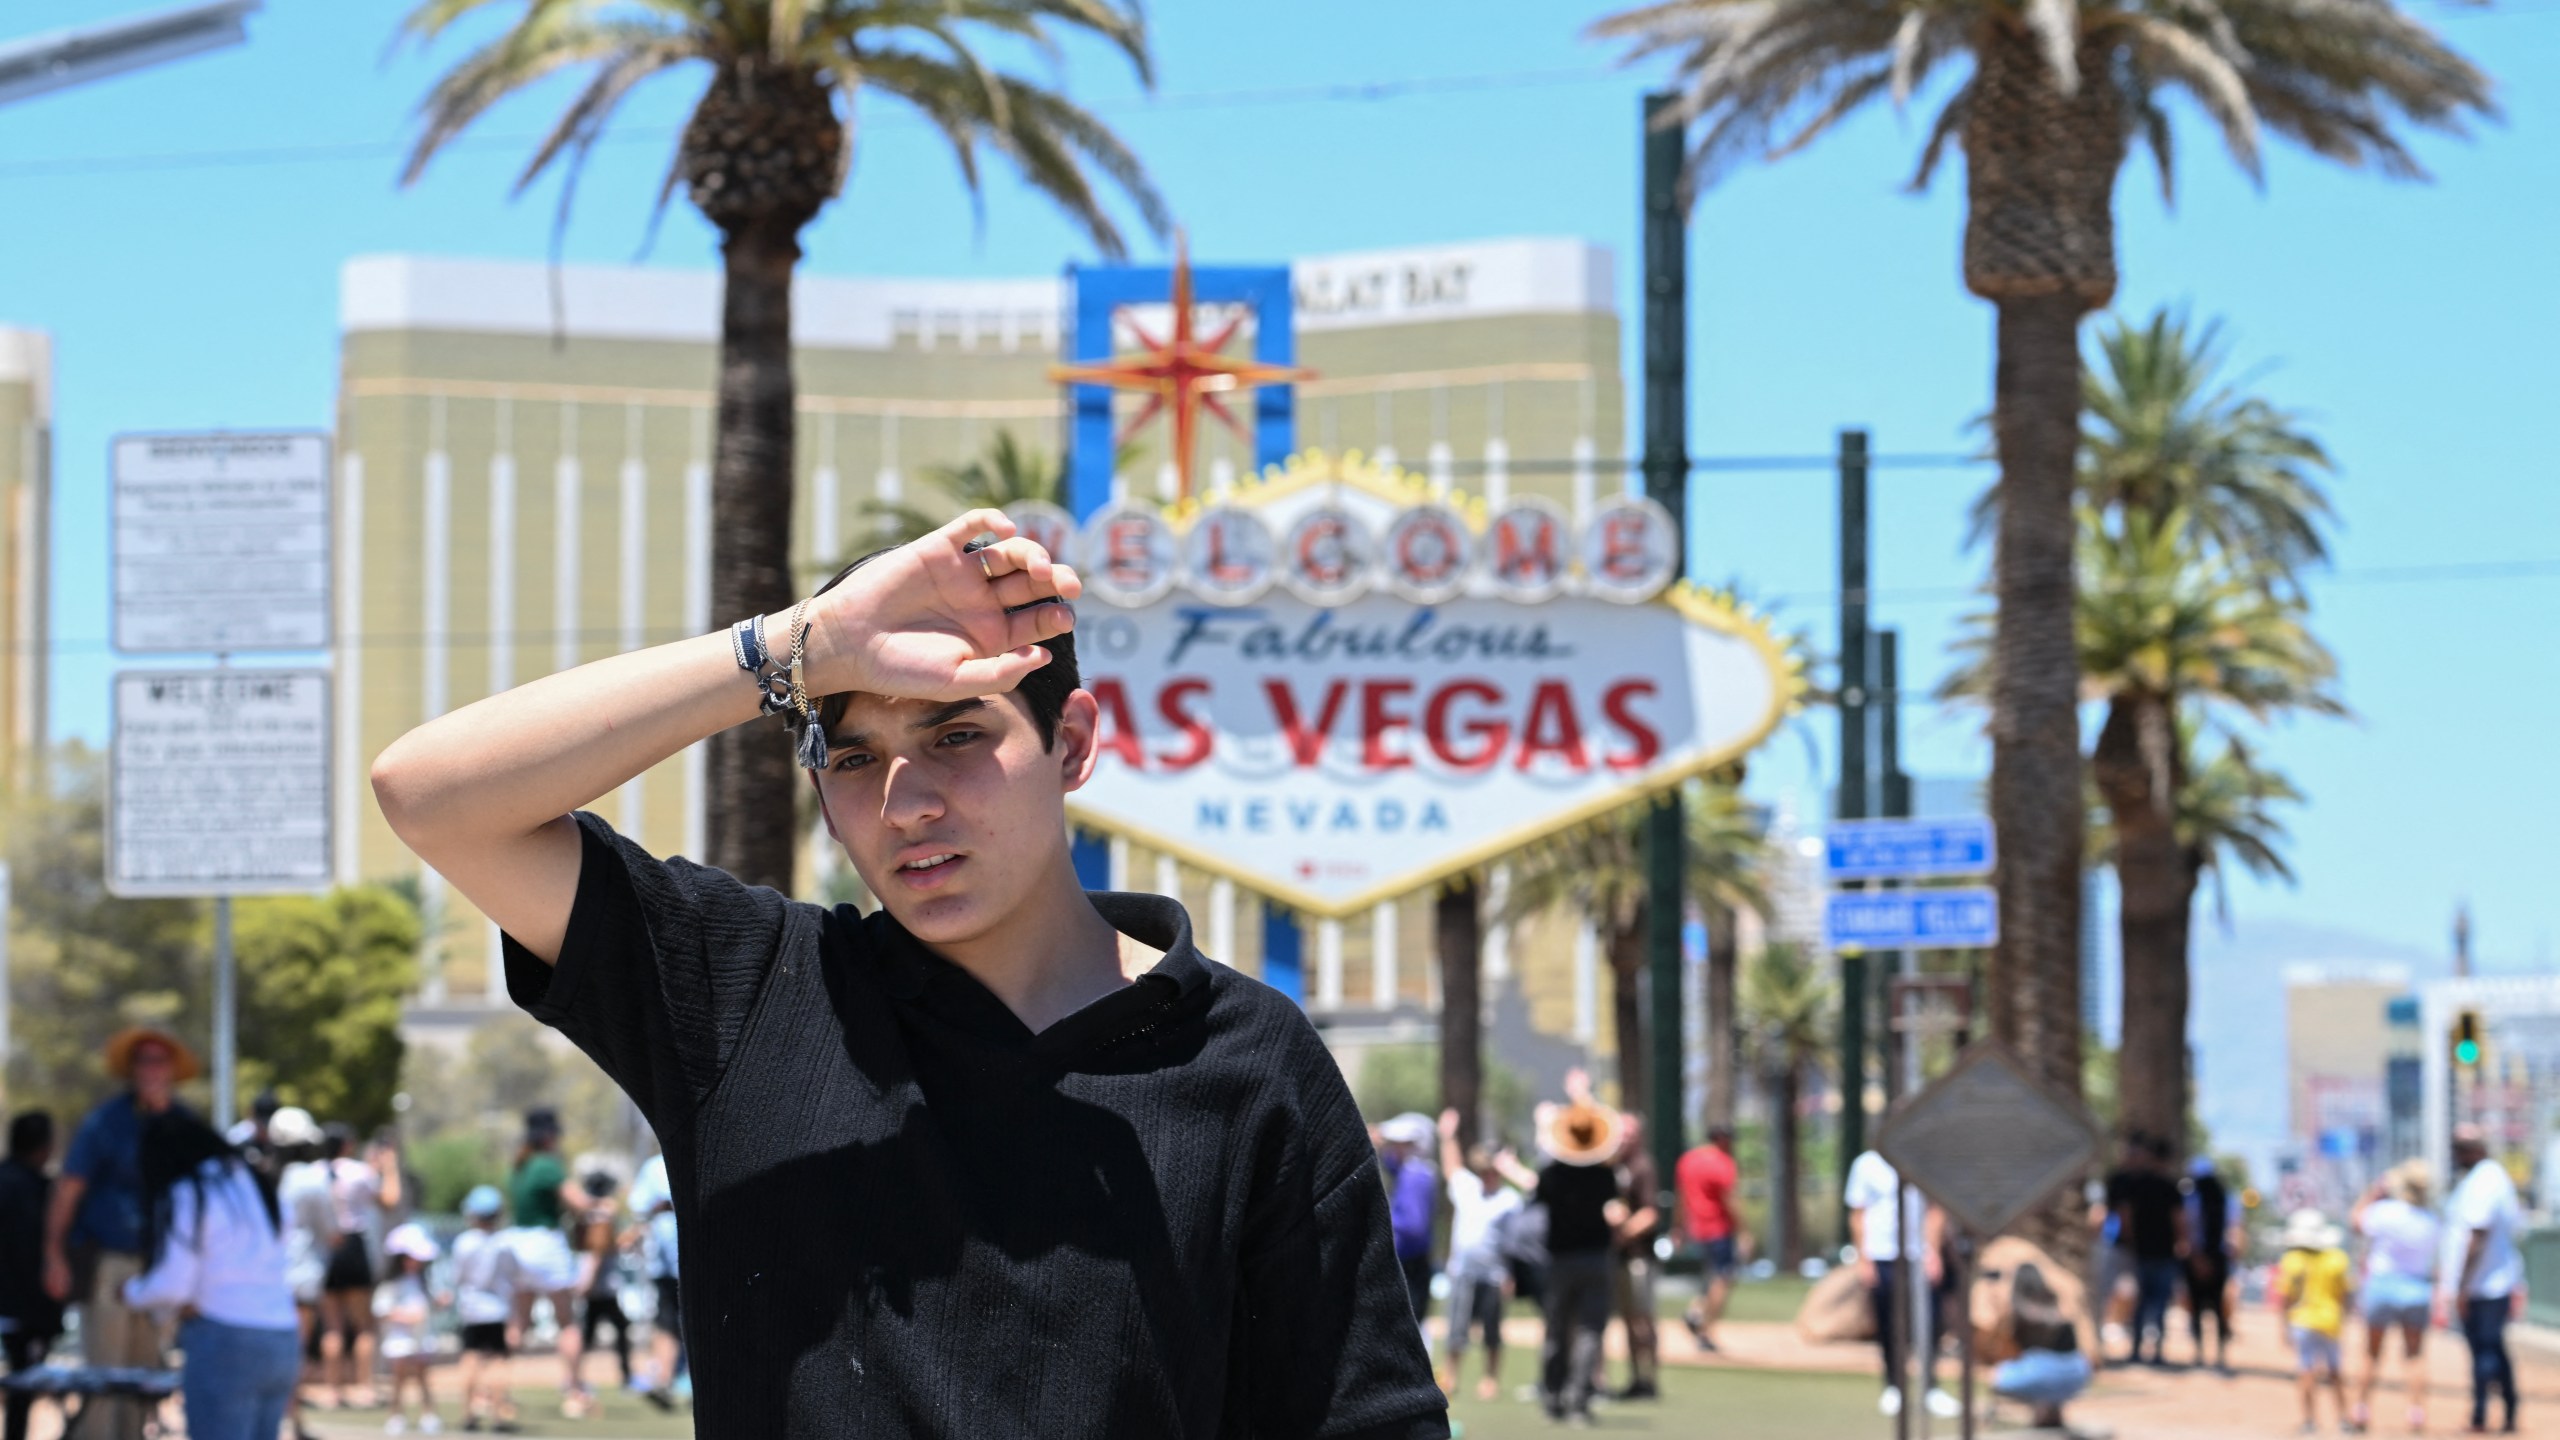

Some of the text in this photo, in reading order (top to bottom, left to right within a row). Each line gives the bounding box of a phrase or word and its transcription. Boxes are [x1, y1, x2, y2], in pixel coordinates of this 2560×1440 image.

[1164, 607, 1574, 668] Fabulous
[151, 677, 293, 702] WELCOME
[1091, 677, 1661, 773] AS VEGAS
[1197, 799, 1448, 833] NEVADA
